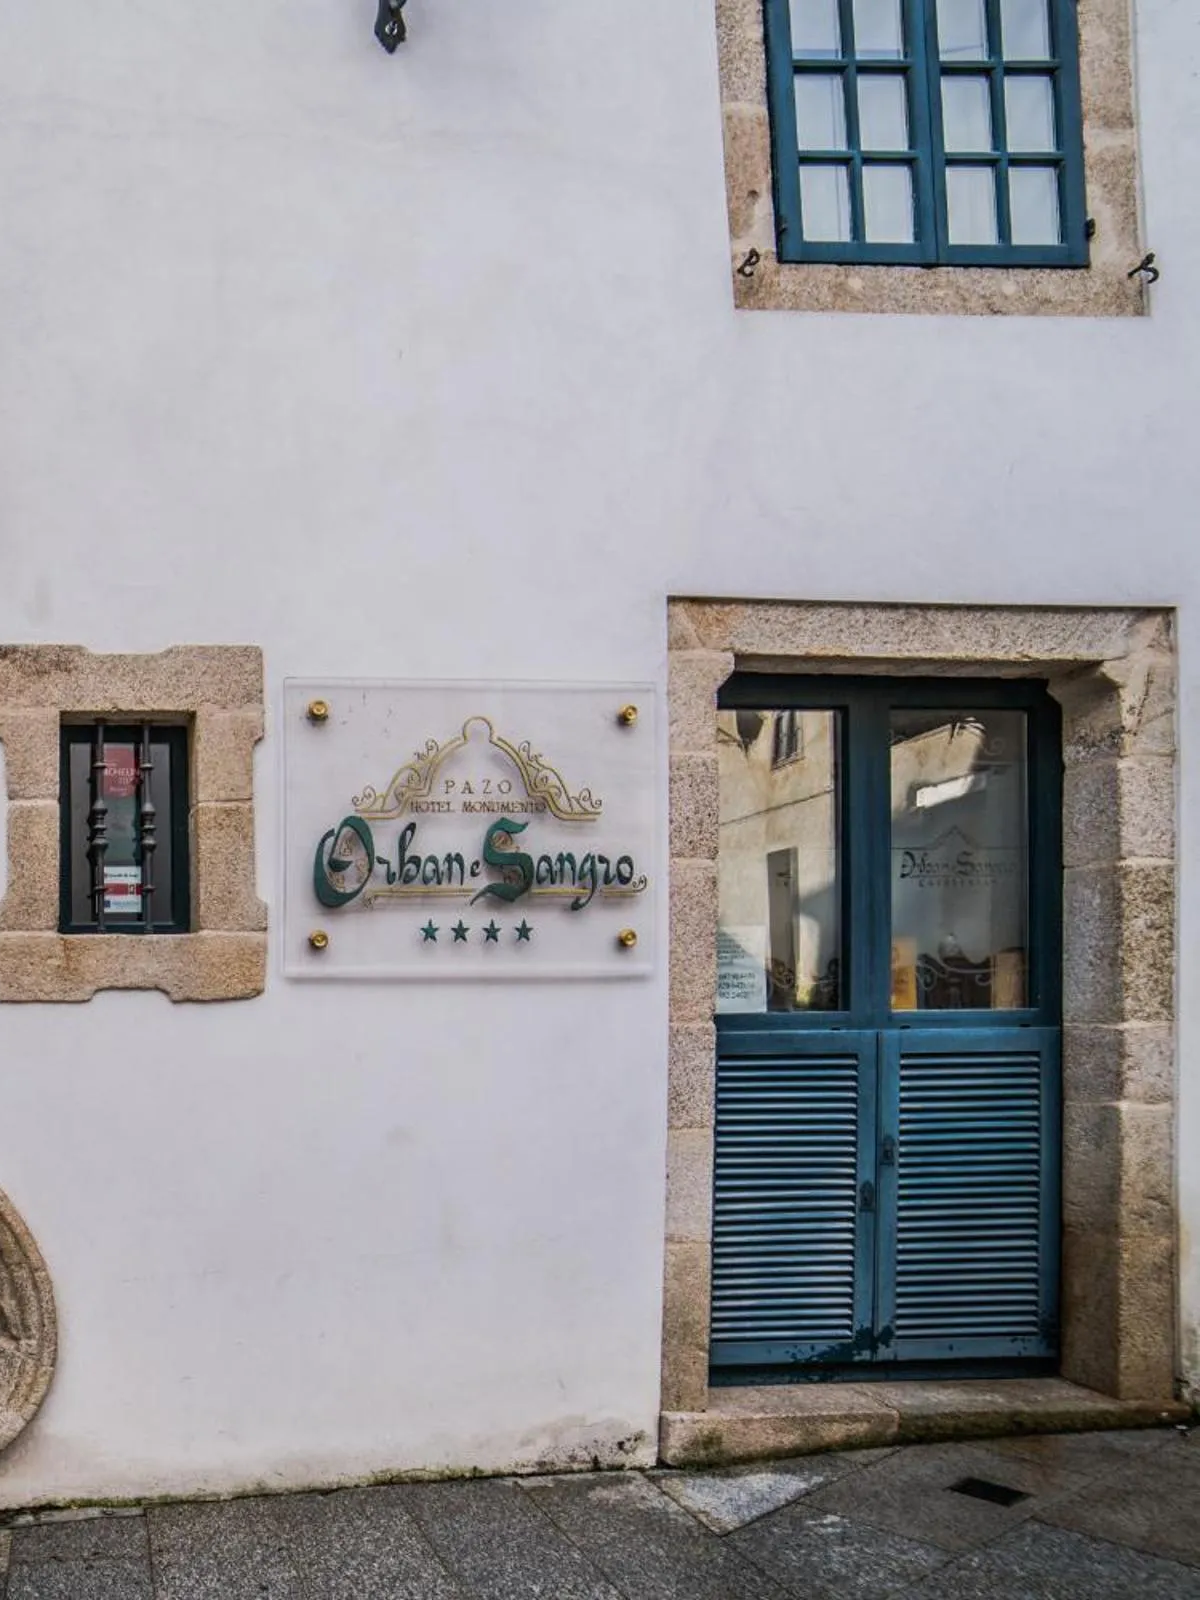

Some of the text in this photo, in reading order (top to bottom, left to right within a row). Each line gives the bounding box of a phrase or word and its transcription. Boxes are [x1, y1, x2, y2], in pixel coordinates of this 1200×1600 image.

[443, 779, 513, 795] PAZO
[409, 800, 547, 814] HOTEL MONUMENTO
[313, 816, 636, 911] Orban e Sangro
